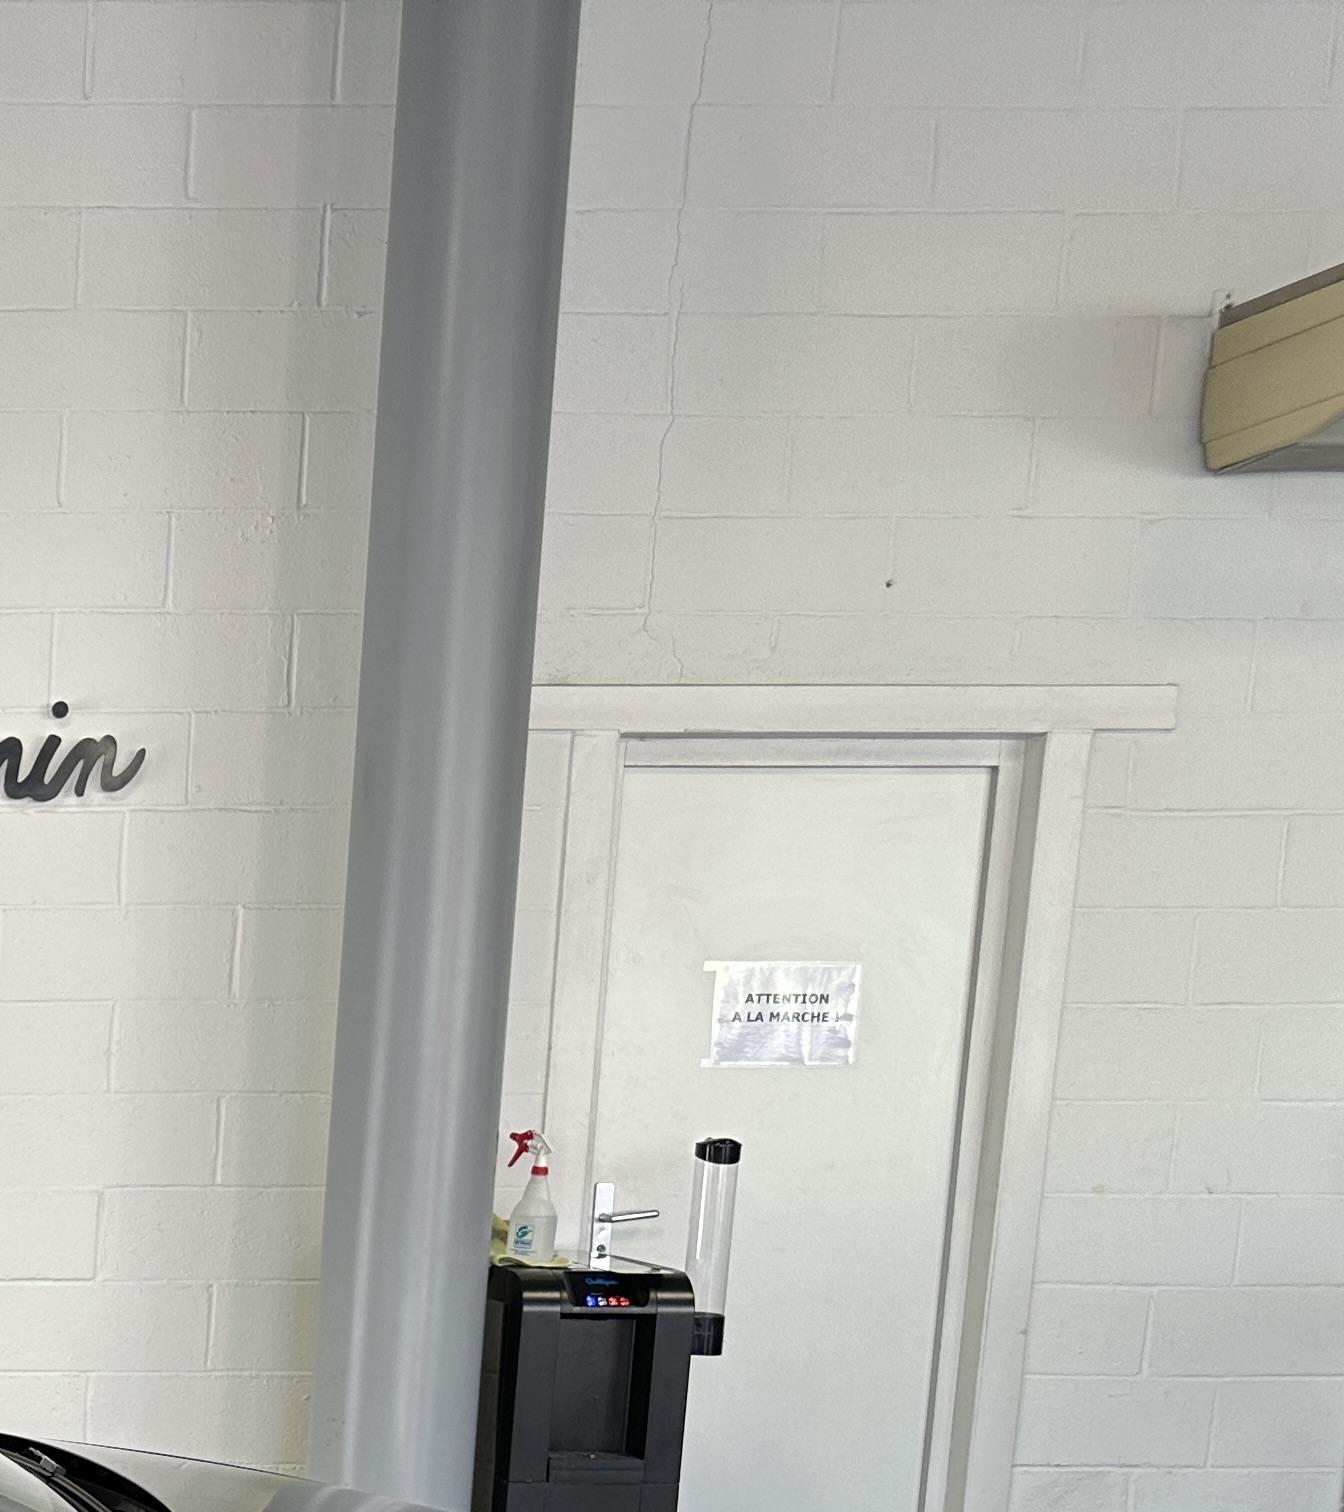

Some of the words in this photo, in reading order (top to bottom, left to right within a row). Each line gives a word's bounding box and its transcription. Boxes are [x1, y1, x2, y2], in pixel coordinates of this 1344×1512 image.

[745, 993, 830, 1005] ATTENTION
[732, 1012, 742, 1023] A
[747, 1012, 764, 1023] LA
[769, 1012, 830, 1023] MARCHE
